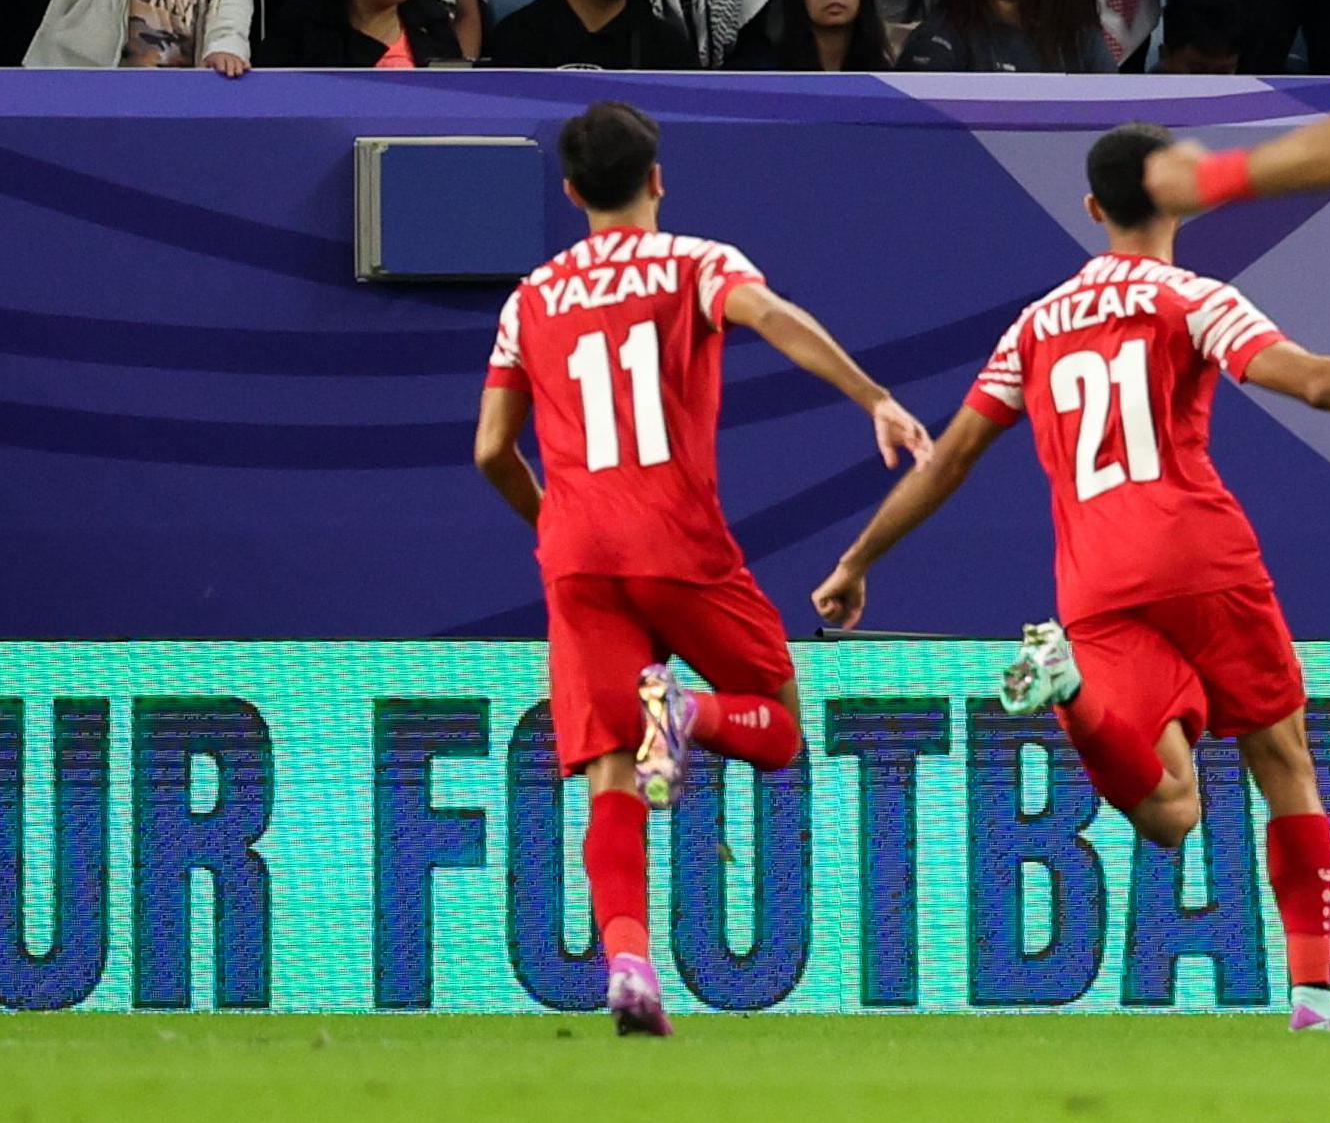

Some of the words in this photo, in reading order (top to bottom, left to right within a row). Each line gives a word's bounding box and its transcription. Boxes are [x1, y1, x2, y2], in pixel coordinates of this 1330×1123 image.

[538, 259, 679, 317] YAZAN
[1033, 283, 1160, 341] NIZAR
[567, 320, 671, 473] 11
[1050, 338, 1161, 503] 21
